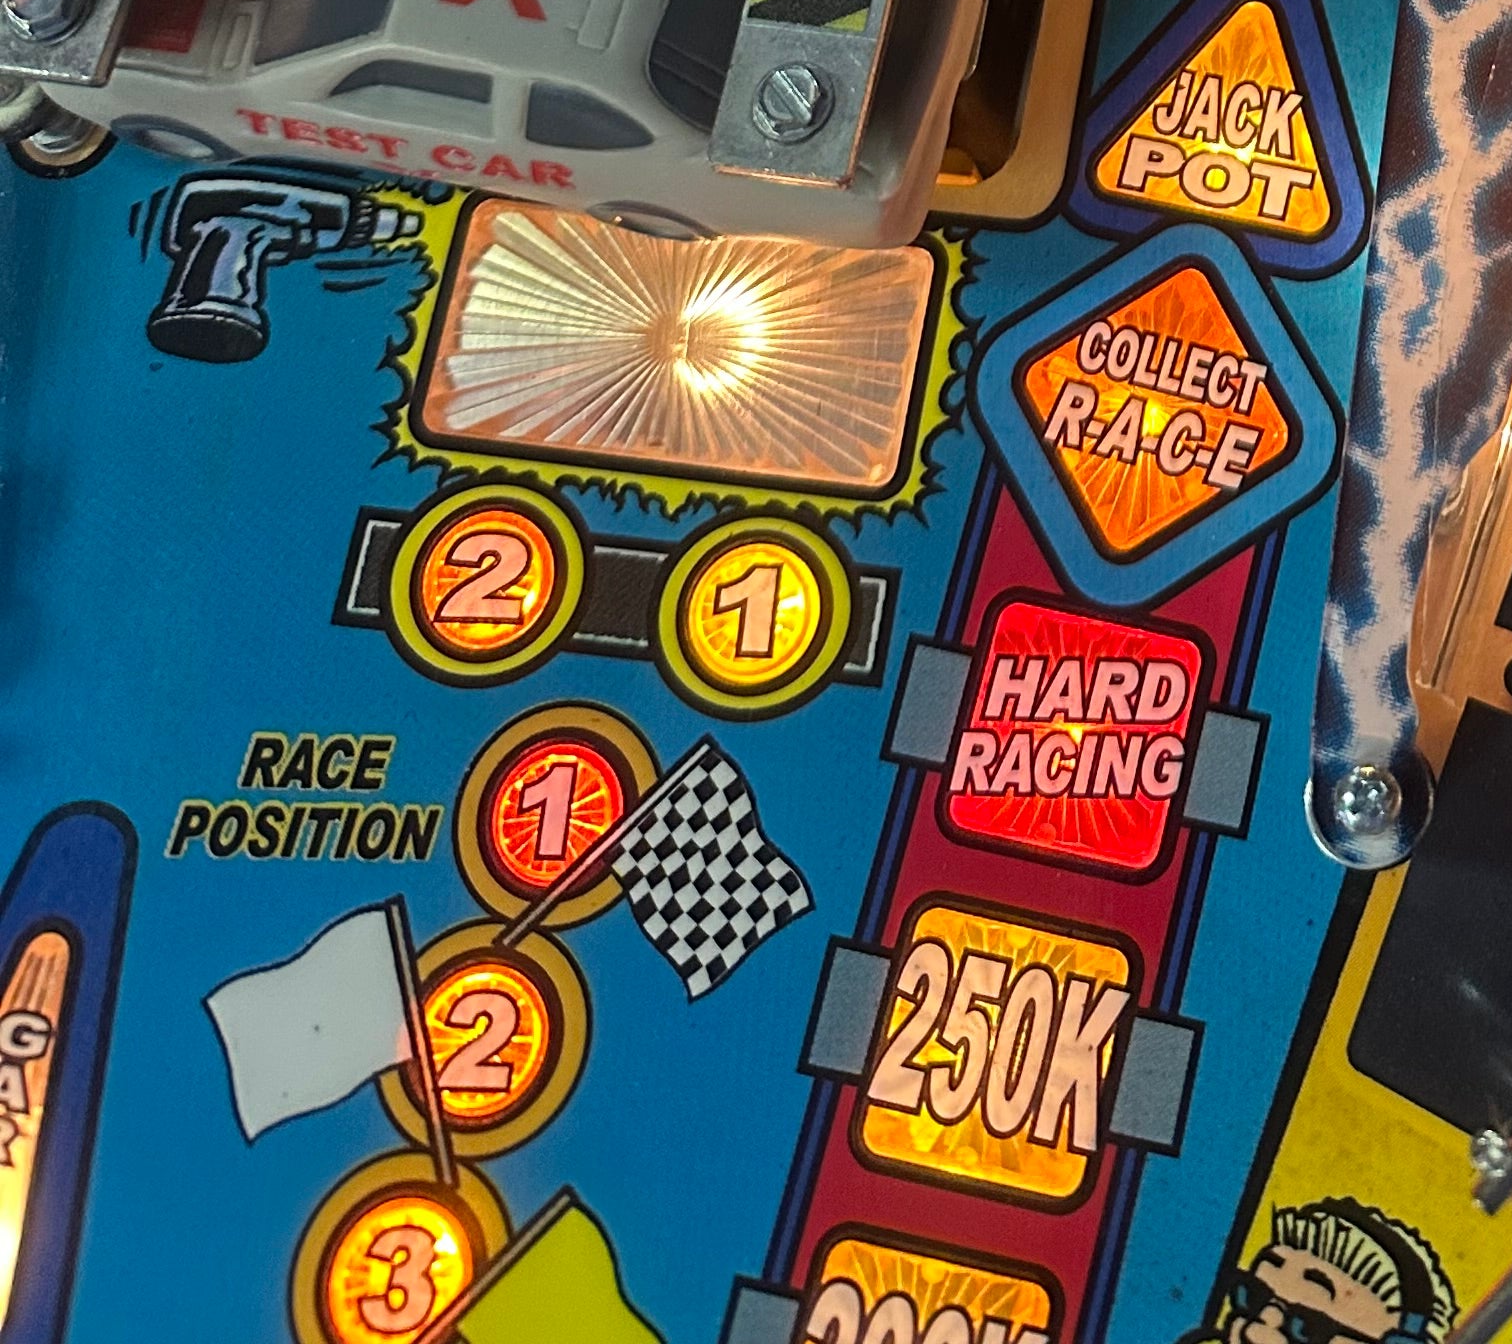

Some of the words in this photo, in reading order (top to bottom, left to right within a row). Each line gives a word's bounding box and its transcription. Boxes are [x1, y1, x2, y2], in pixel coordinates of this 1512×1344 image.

[236, 109, 409, 160] TEST
[430, 144, 577, 189] CAR
[1152, 70, 1304, 160] JACK
[1116, 135, 1317, 223] POT
[1077, 319, 1268, 414] COLLECT
[1043, 380, 1265, 491] R-A-C-E
[432, 528, 532, 627] 2
[713, 563, 787, 659] 1
[979, 655, 1190, 724] HARD
[241, 736, 394, 791] RACE
[948, 728, 1186, 800] RACING
[168, 804, 443, 861] POSITION
[519, 762, 577, 862] 1
[436, 988, 520, 1094] 2
[866, 936, 1133, 1155] 250K
[356, 1223, 439, 1336] 3
